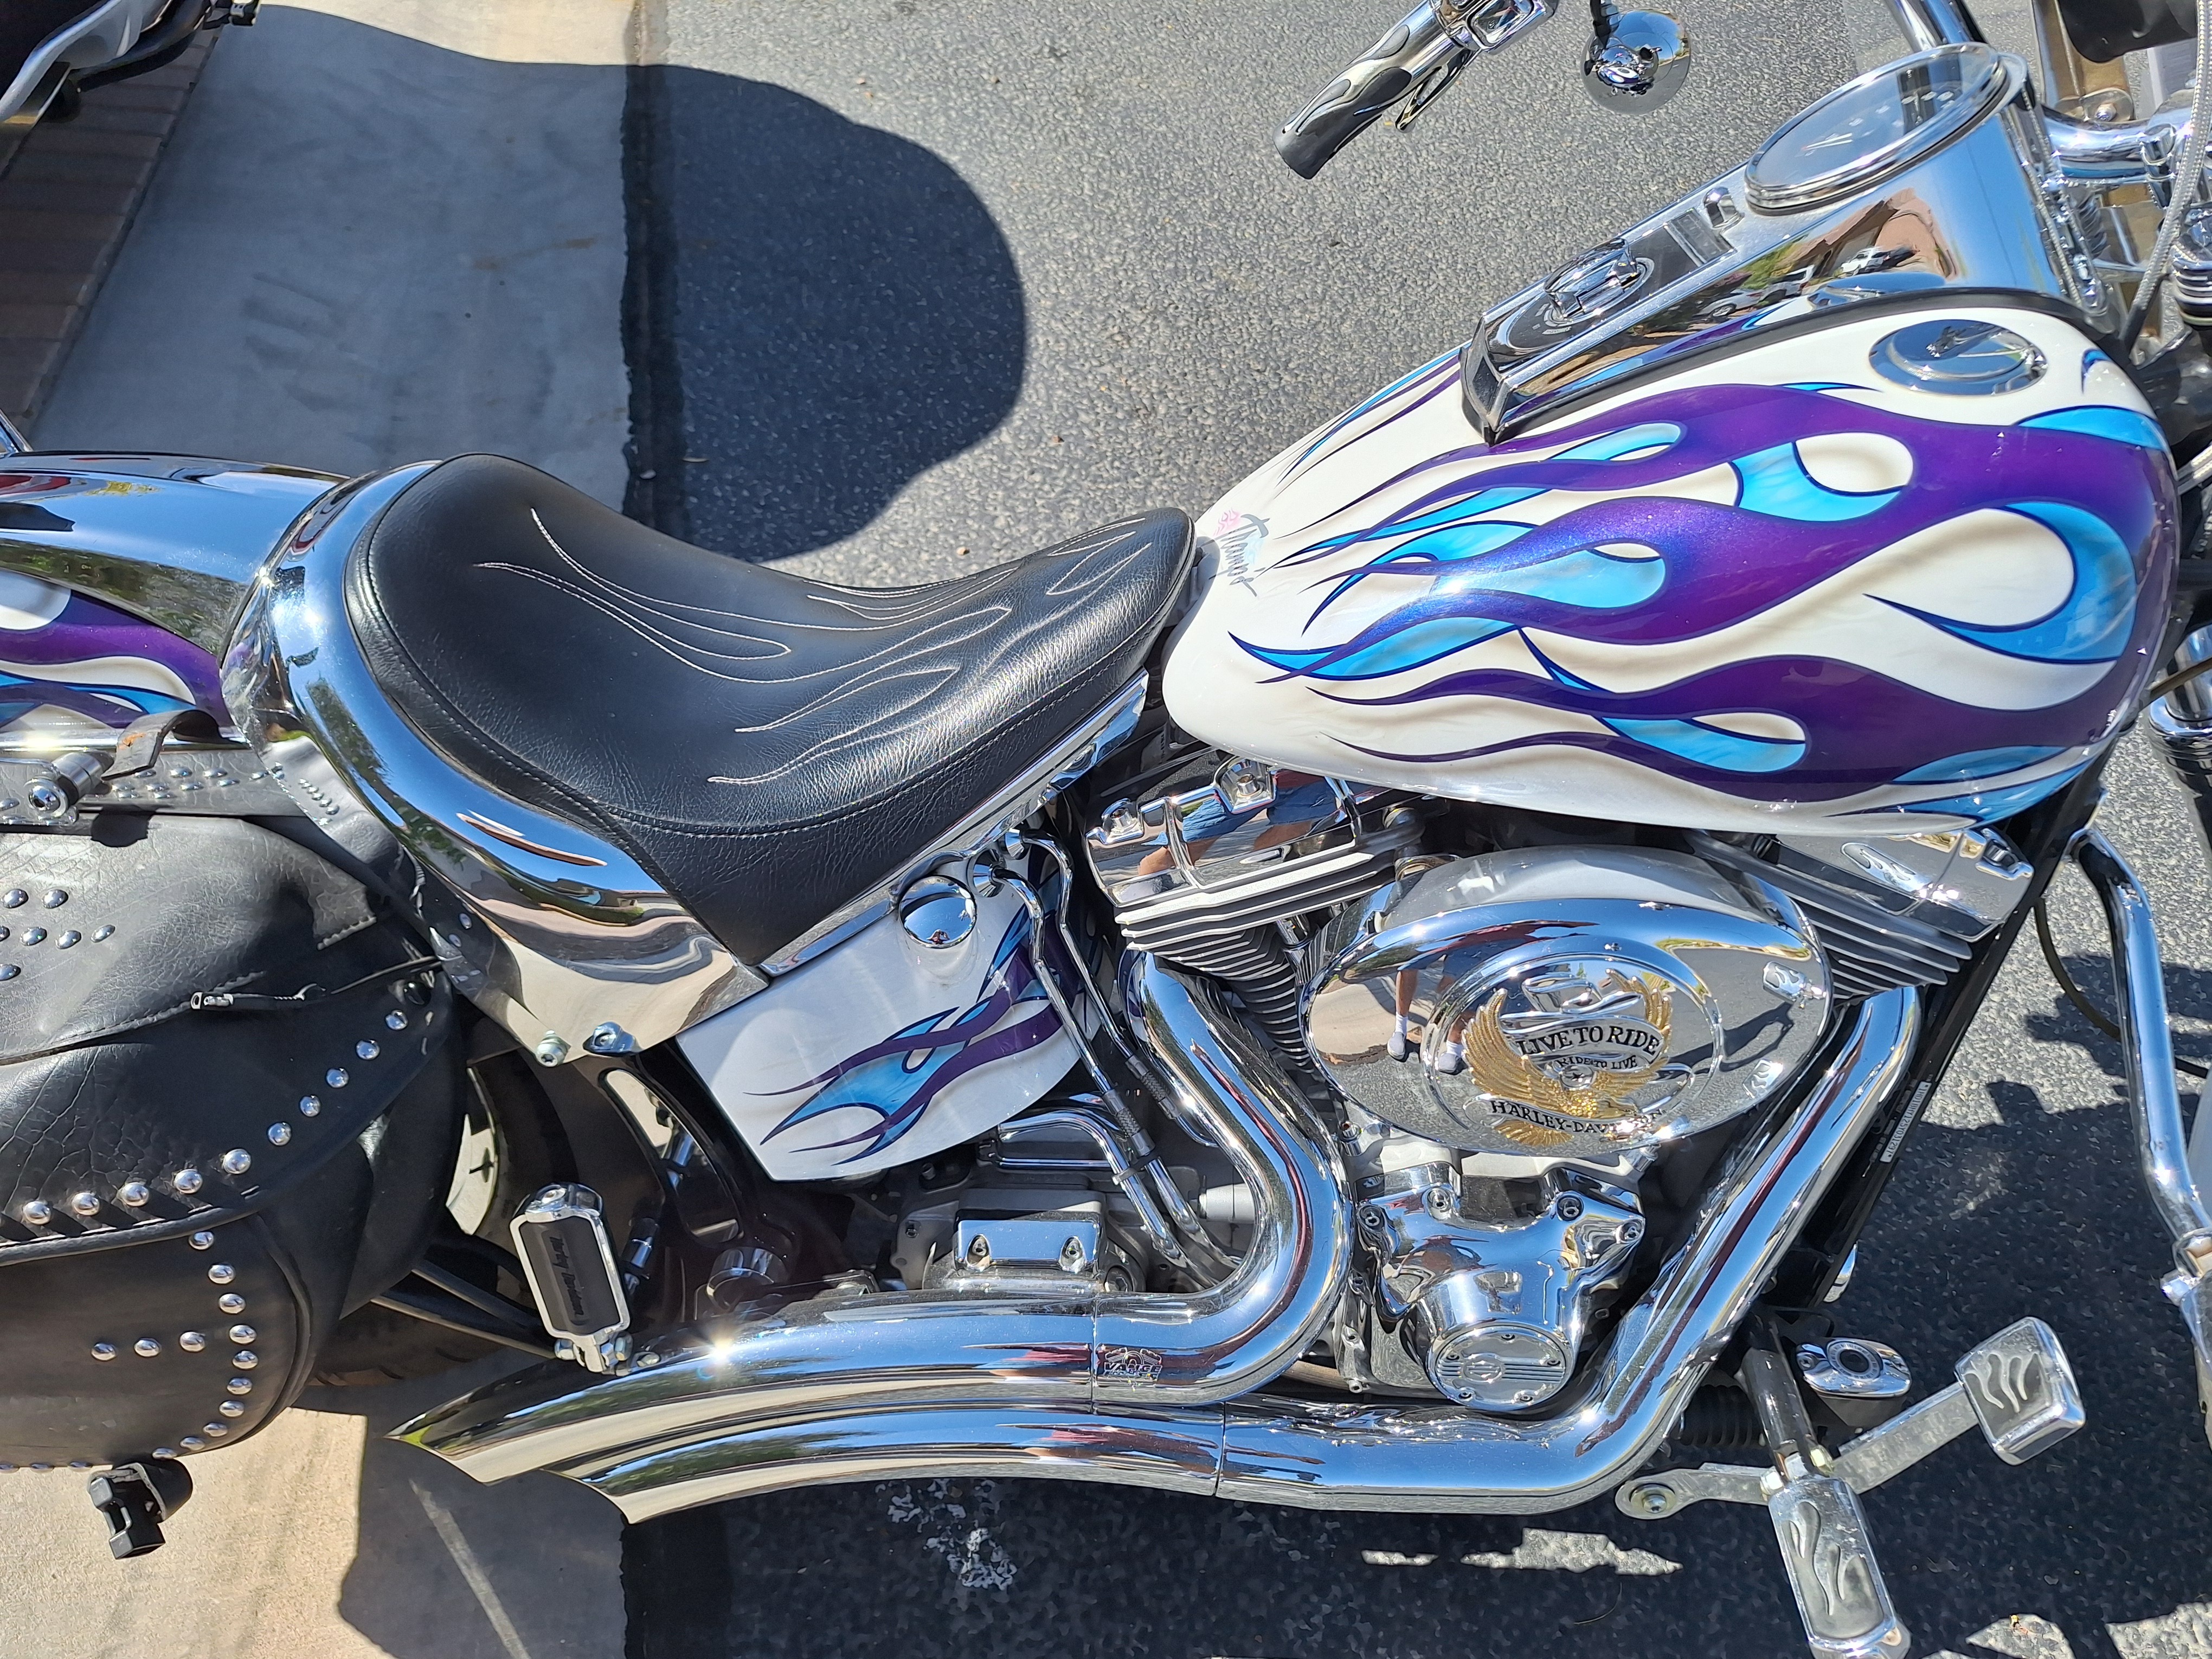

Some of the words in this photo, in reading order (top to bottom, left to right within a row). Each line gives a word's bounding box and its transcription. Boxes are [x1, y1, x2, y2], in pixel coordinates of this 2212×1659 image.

[1517, 1033, 1572, 1055] LIVE
[1571, 1026, 1604, 1043] TO
[1606, 1026, 1661, 1056] RIDE
[1555, 1056, 1591, 1067] RIDE
[1610, 1056, 1637, 1069] LIVE
[1490, 1100, 1663, 1133] HARLEY-DAVN
